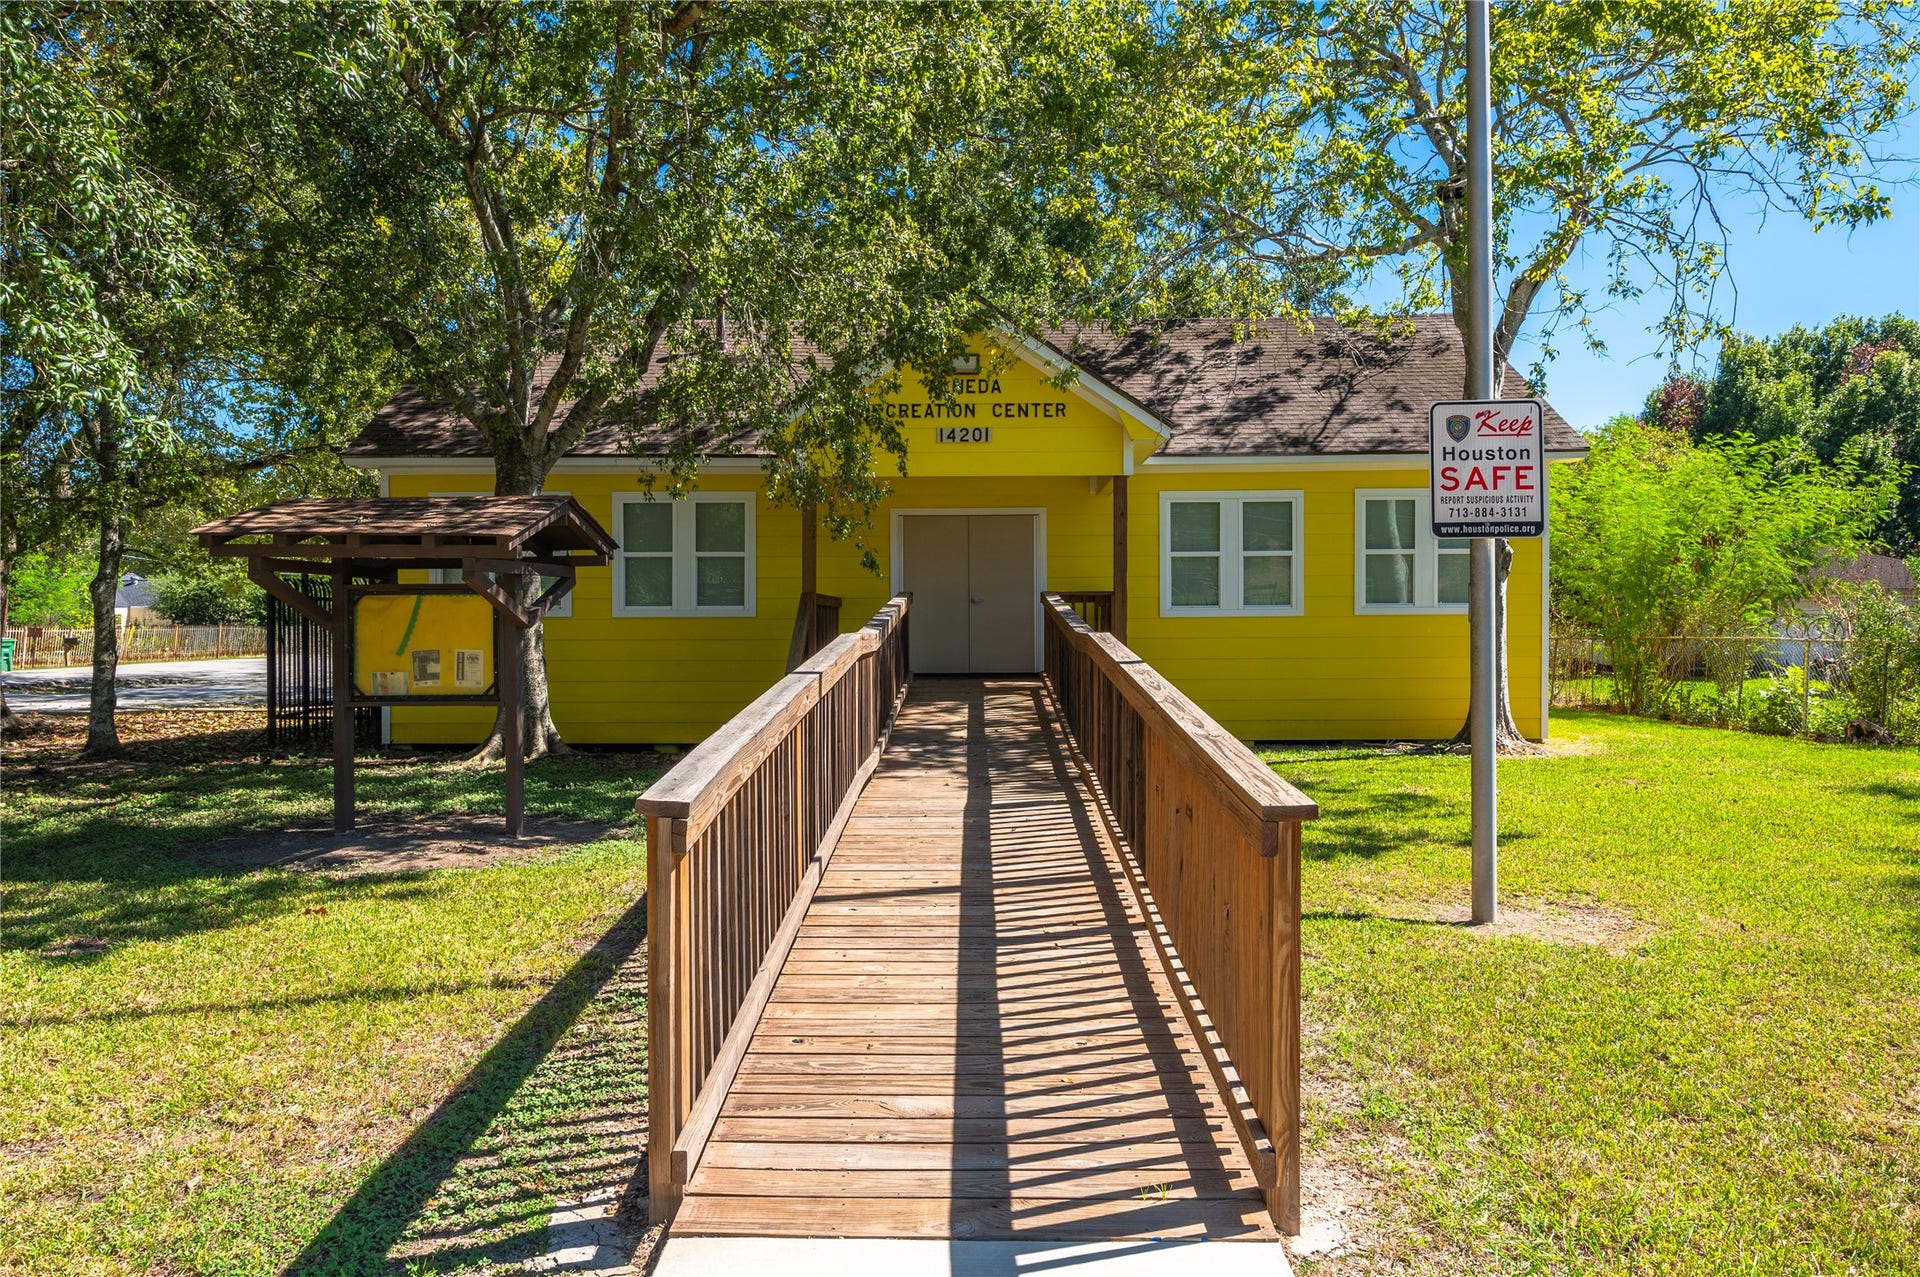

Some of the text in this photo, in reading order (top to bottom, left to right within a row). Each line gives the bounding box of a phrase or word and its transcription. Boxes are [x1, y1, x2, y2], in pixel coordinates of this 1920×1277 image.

[860, 403, 1067, 418] CREATION CENTER
[1475, 409, 1534, 438] Keep
[939, 427, 990, 442] 14201
[1442, 446, 1531, 461] Houston
[1440, 466, 1535, 491] SAFE
[1440, 495, 1534, 505] REPORT SUSPICIOUS ACTIVITY
[1448, 507, 1527, 518] 713-884-3131
[1440, 524, 1536, 535] www.houstonpolice.org
